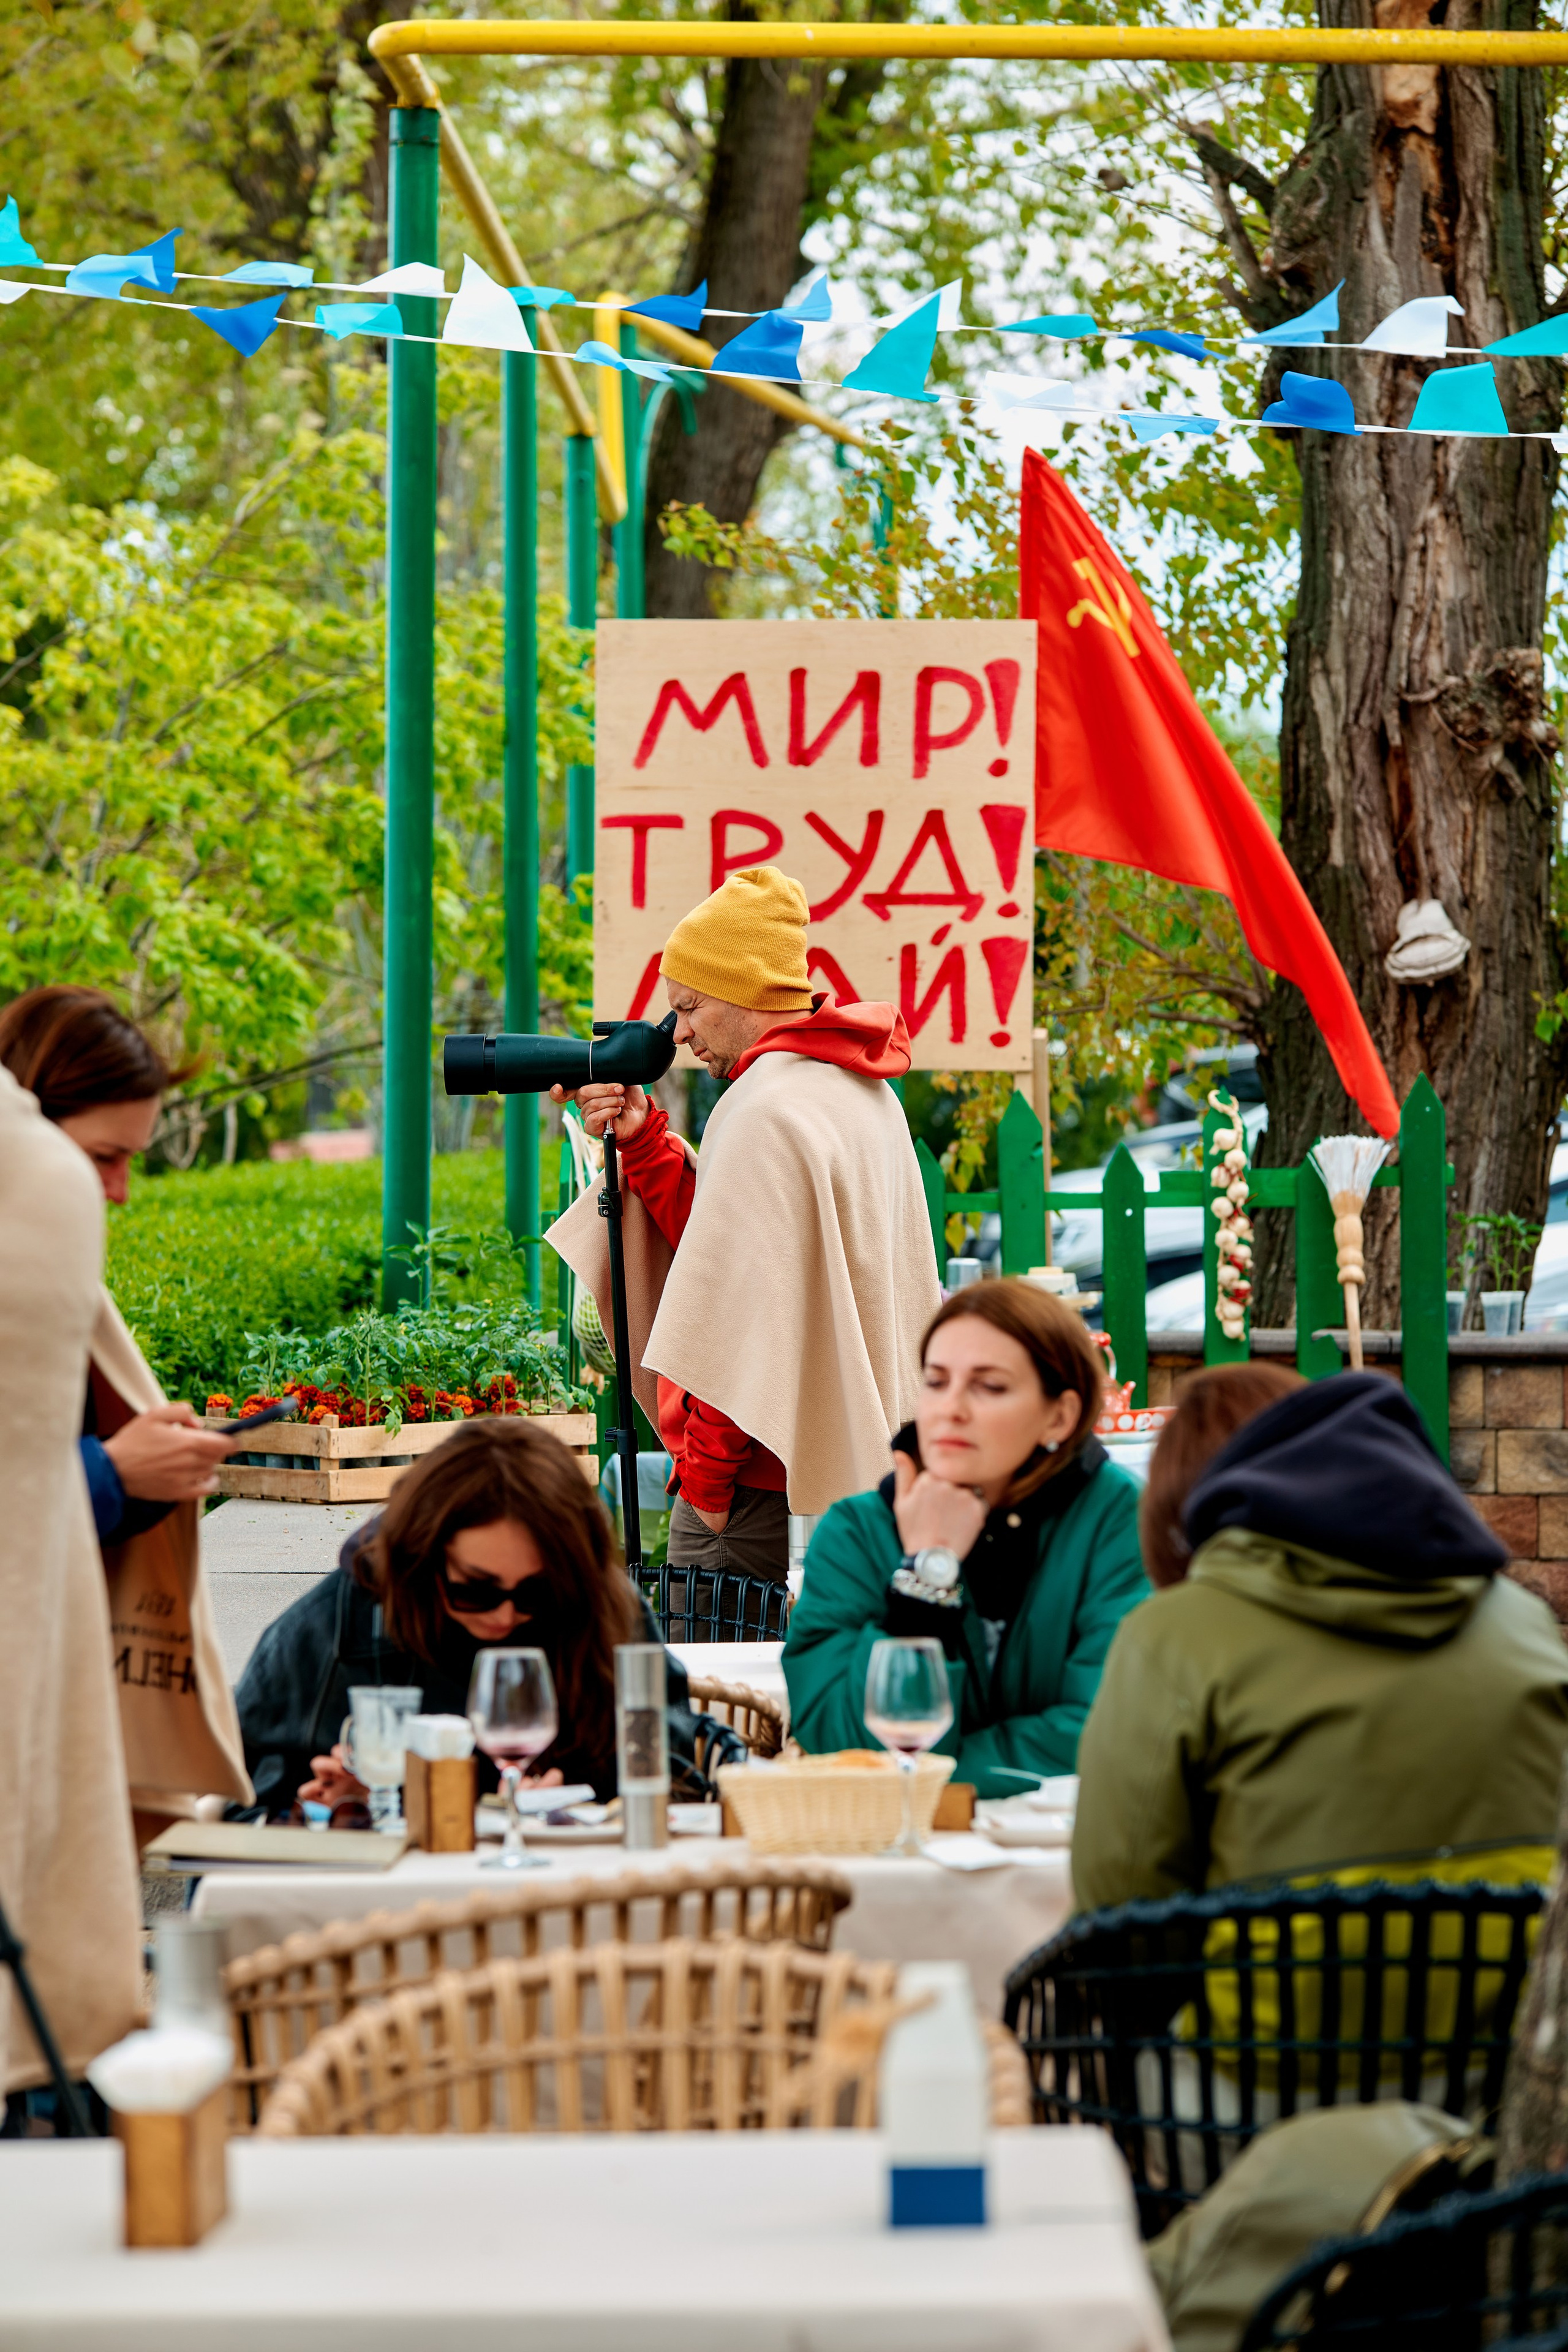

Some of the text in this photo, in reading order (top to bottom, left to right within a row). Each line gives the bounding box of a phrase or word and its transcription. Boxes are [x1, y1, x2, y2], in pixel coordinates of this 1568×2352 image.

[633, 658, 1020, 779] МИР!
[600, 803, 1027, 924] ТРУД!
[625, 924, 1029, 1048] АЙ!
